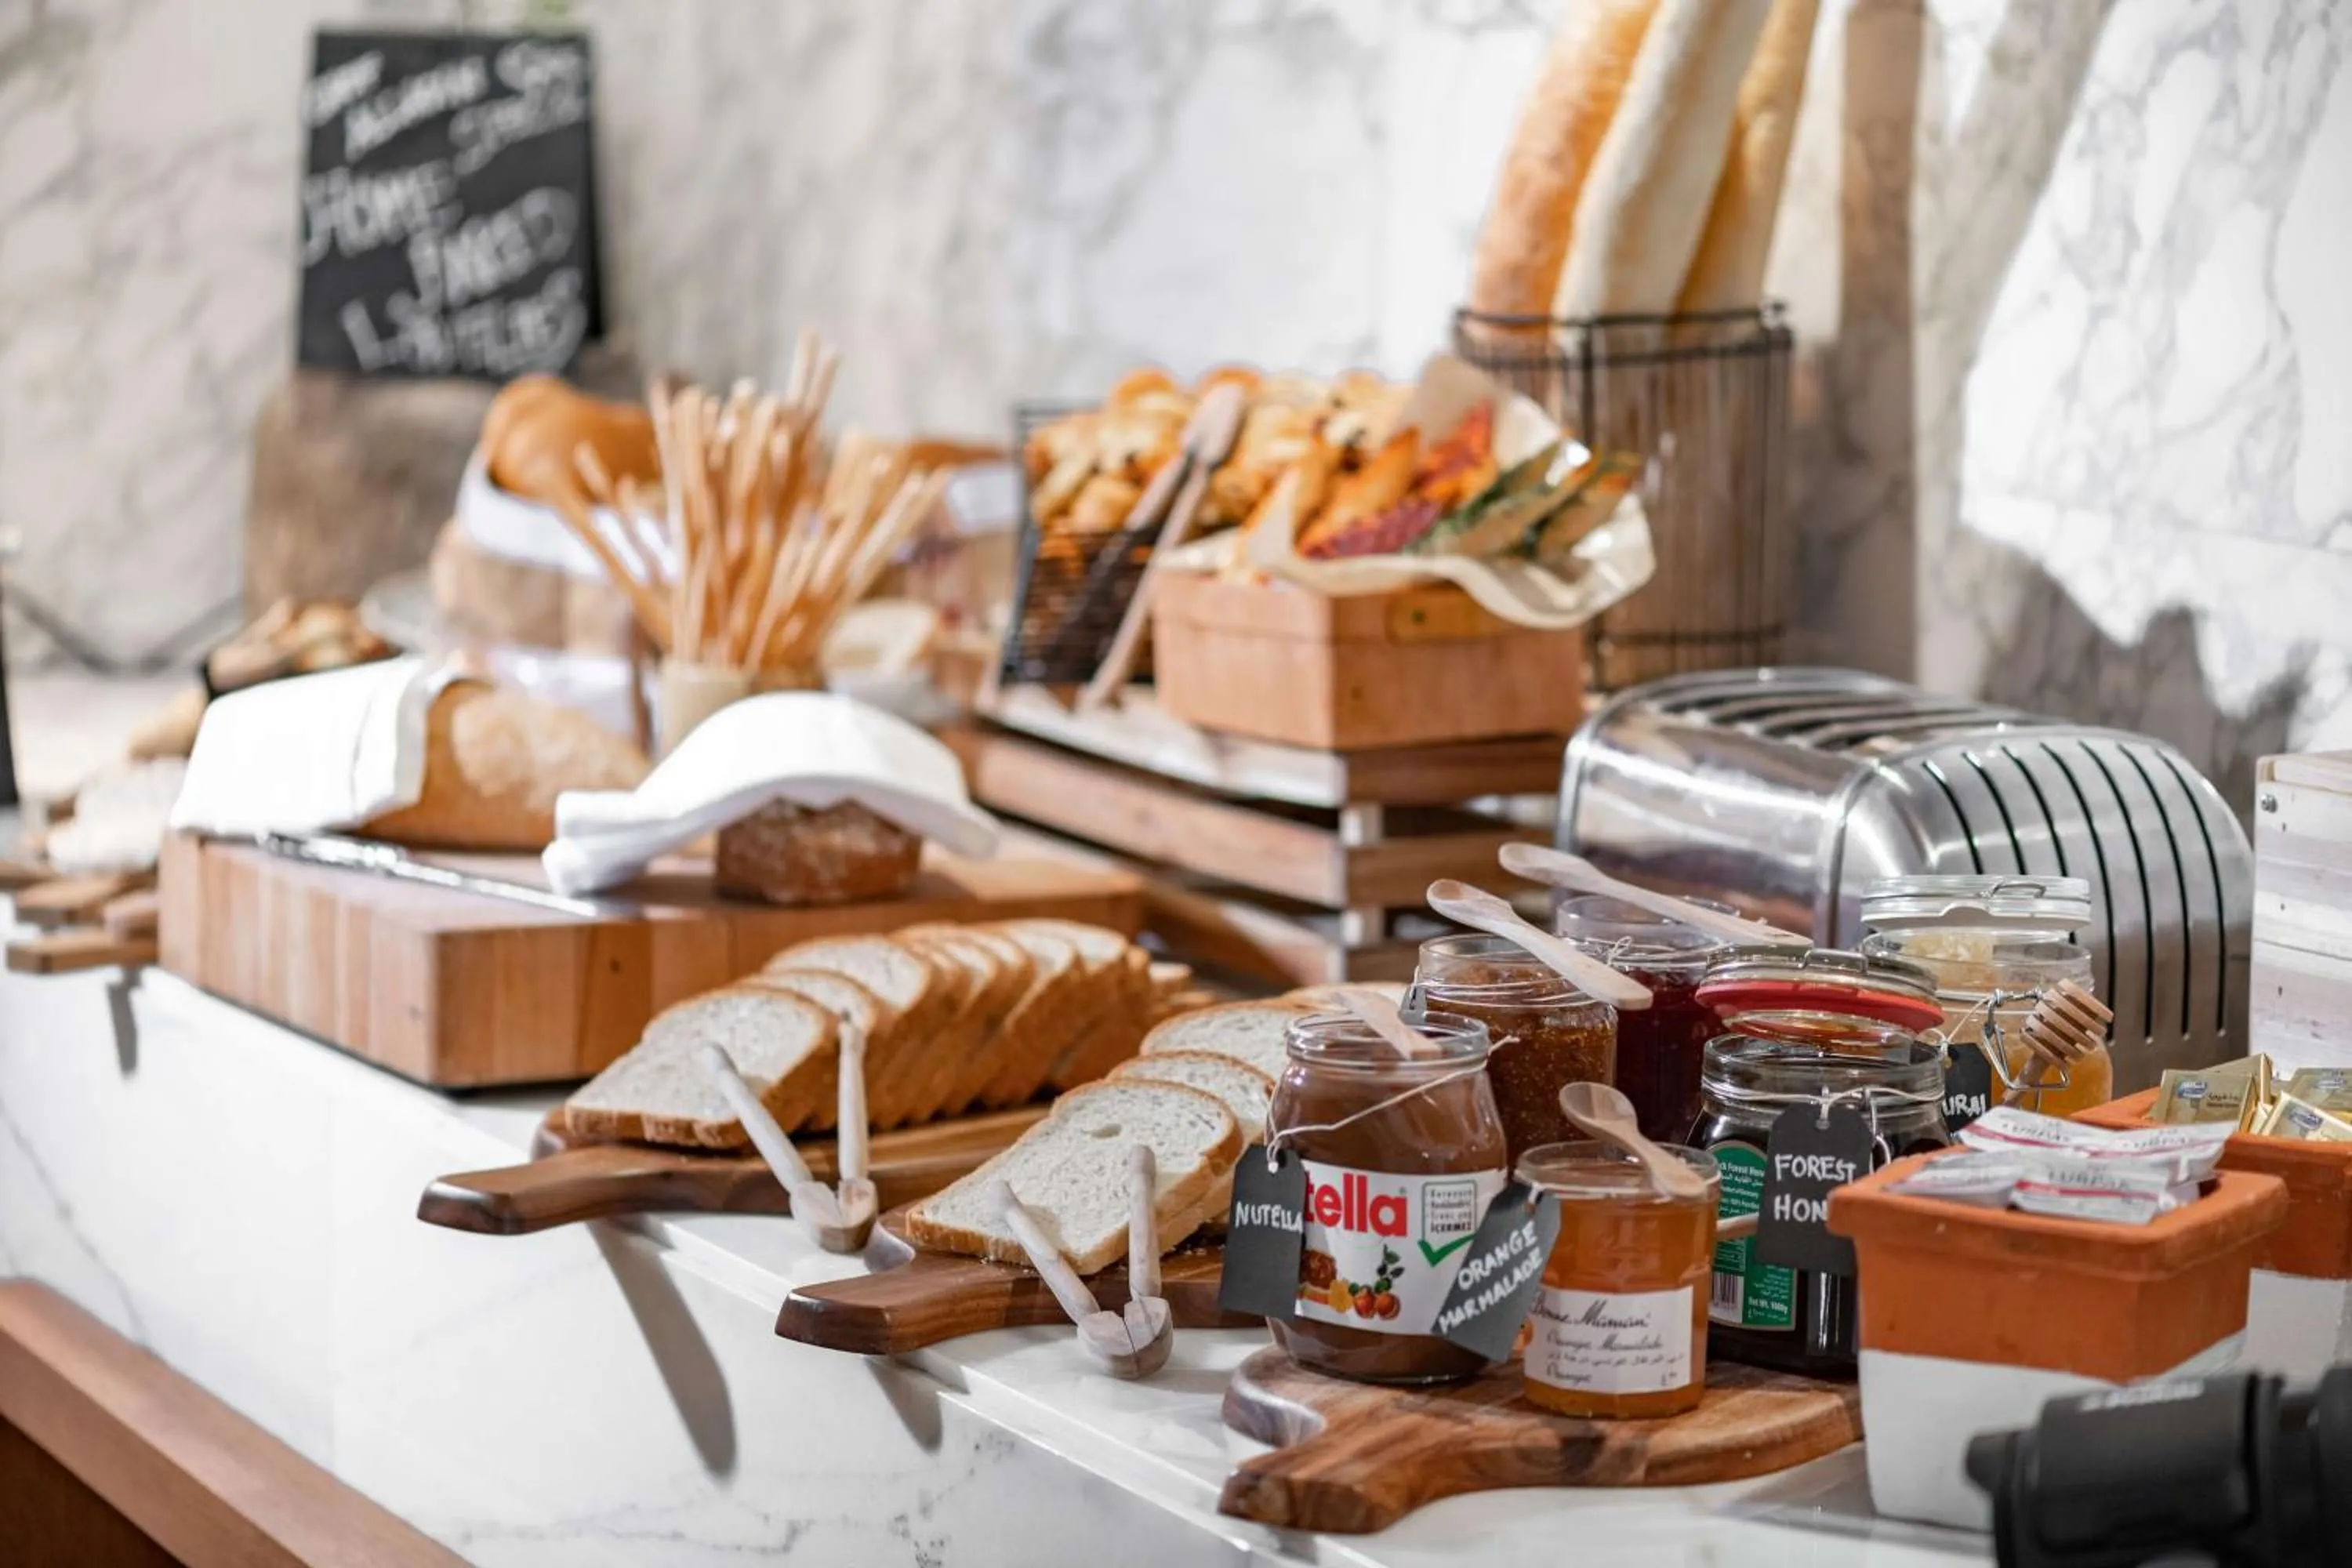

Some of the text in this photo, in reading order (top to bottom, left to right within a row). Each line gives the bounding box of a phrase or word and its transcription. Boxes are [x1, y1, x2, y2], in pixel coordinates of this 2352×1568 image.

[1774, 1153, 1857, 1186] FOREST
[1235, 1200, 1304, 1234] NUTELLA
[1305, 1171, 1407, 1237] tella
[1773, 1192, 1828, 1223] HON
[1458, 1219, 1538, 1290] ORANGE
[1438, 1246, 1544, 1335] MARMALADE
